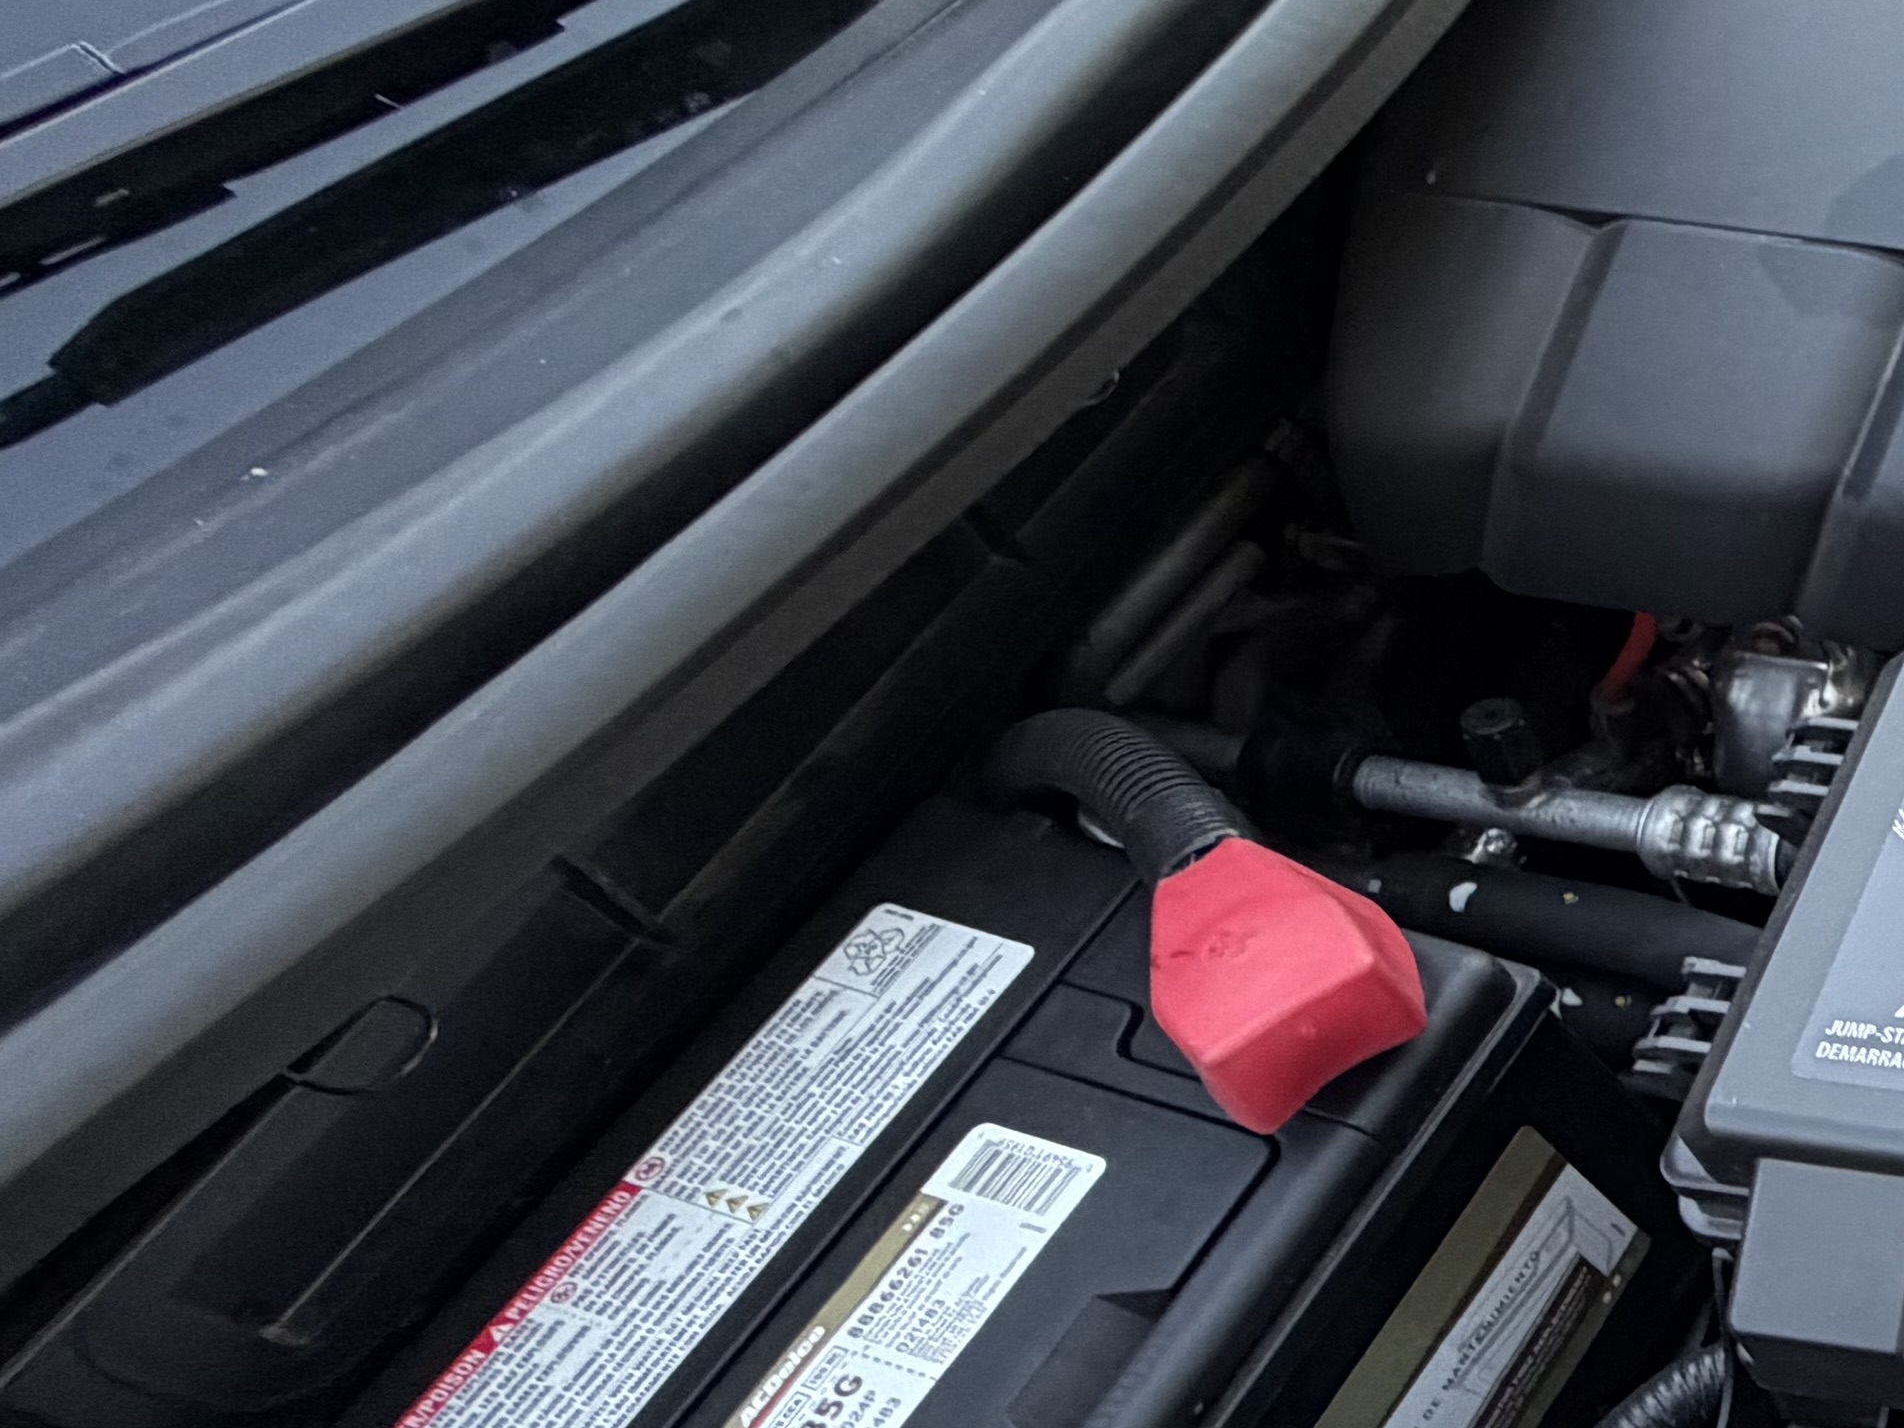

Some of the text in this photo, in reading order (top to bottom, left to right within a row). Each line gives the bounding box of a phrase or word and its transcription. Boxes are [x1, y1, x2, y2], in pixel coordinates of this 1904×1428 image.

[503, 1189, 634, 1321] PELIGRO/VENENO
[844, 1246, 930, 1339] 88866261
[925, 1201, 967, 1239] 85G
[738, 1325, 827, 1428] ACDelco
[1422, 1398, 1441, 1422] DE
[1441, 1249, 1541, 1391] MANTENIMIENTO
